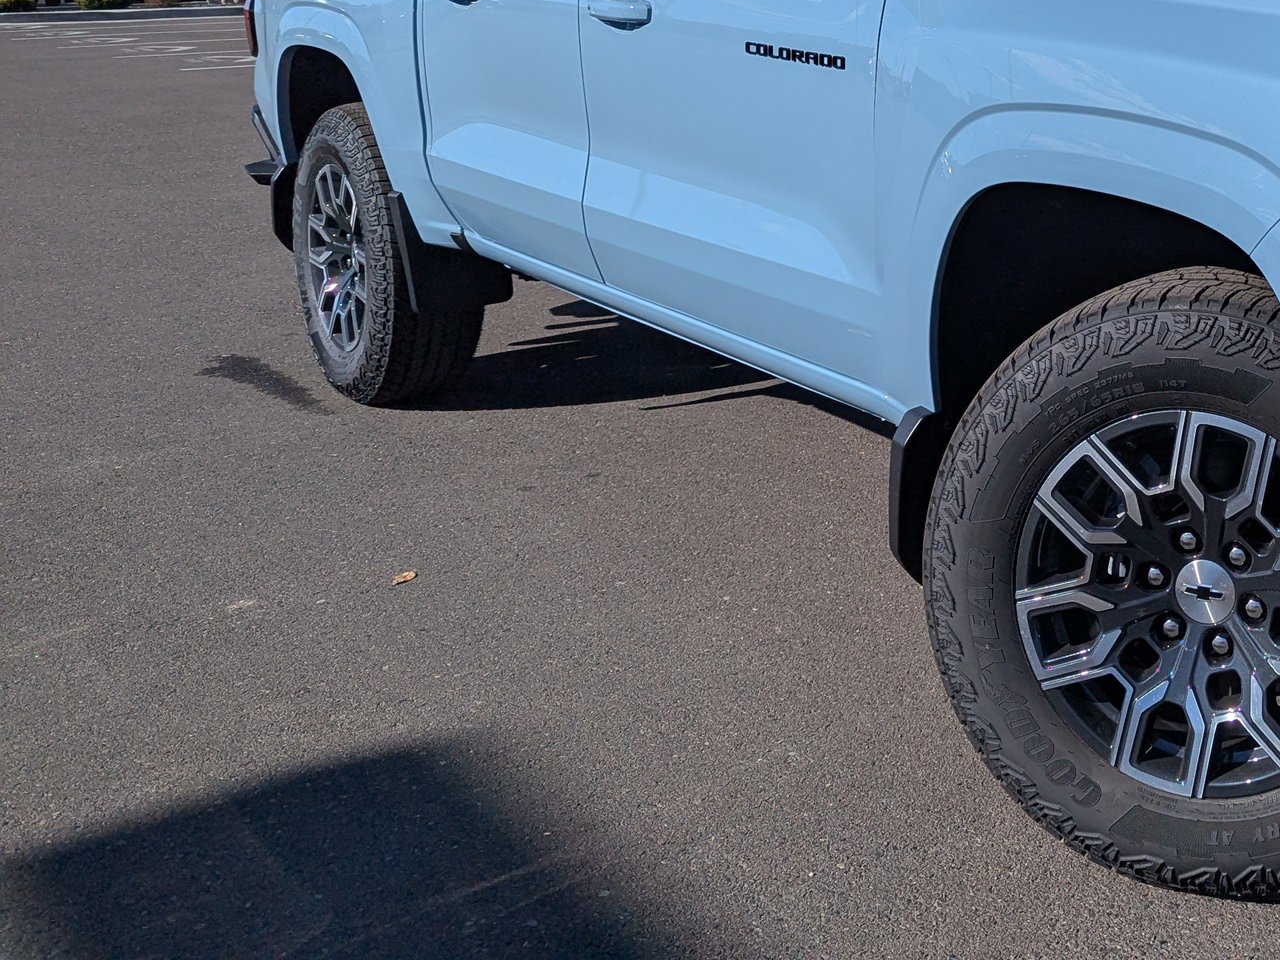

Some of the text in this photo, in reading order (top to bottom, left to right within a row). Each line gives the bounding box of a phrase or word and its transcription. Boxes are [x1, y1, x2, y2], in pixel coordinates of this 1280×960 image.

[745, 41, 845, 70] COLORADO
[1064, 386, 1090, 403] SPEC
[966, 547, 1103, 809] GOODYEAR
